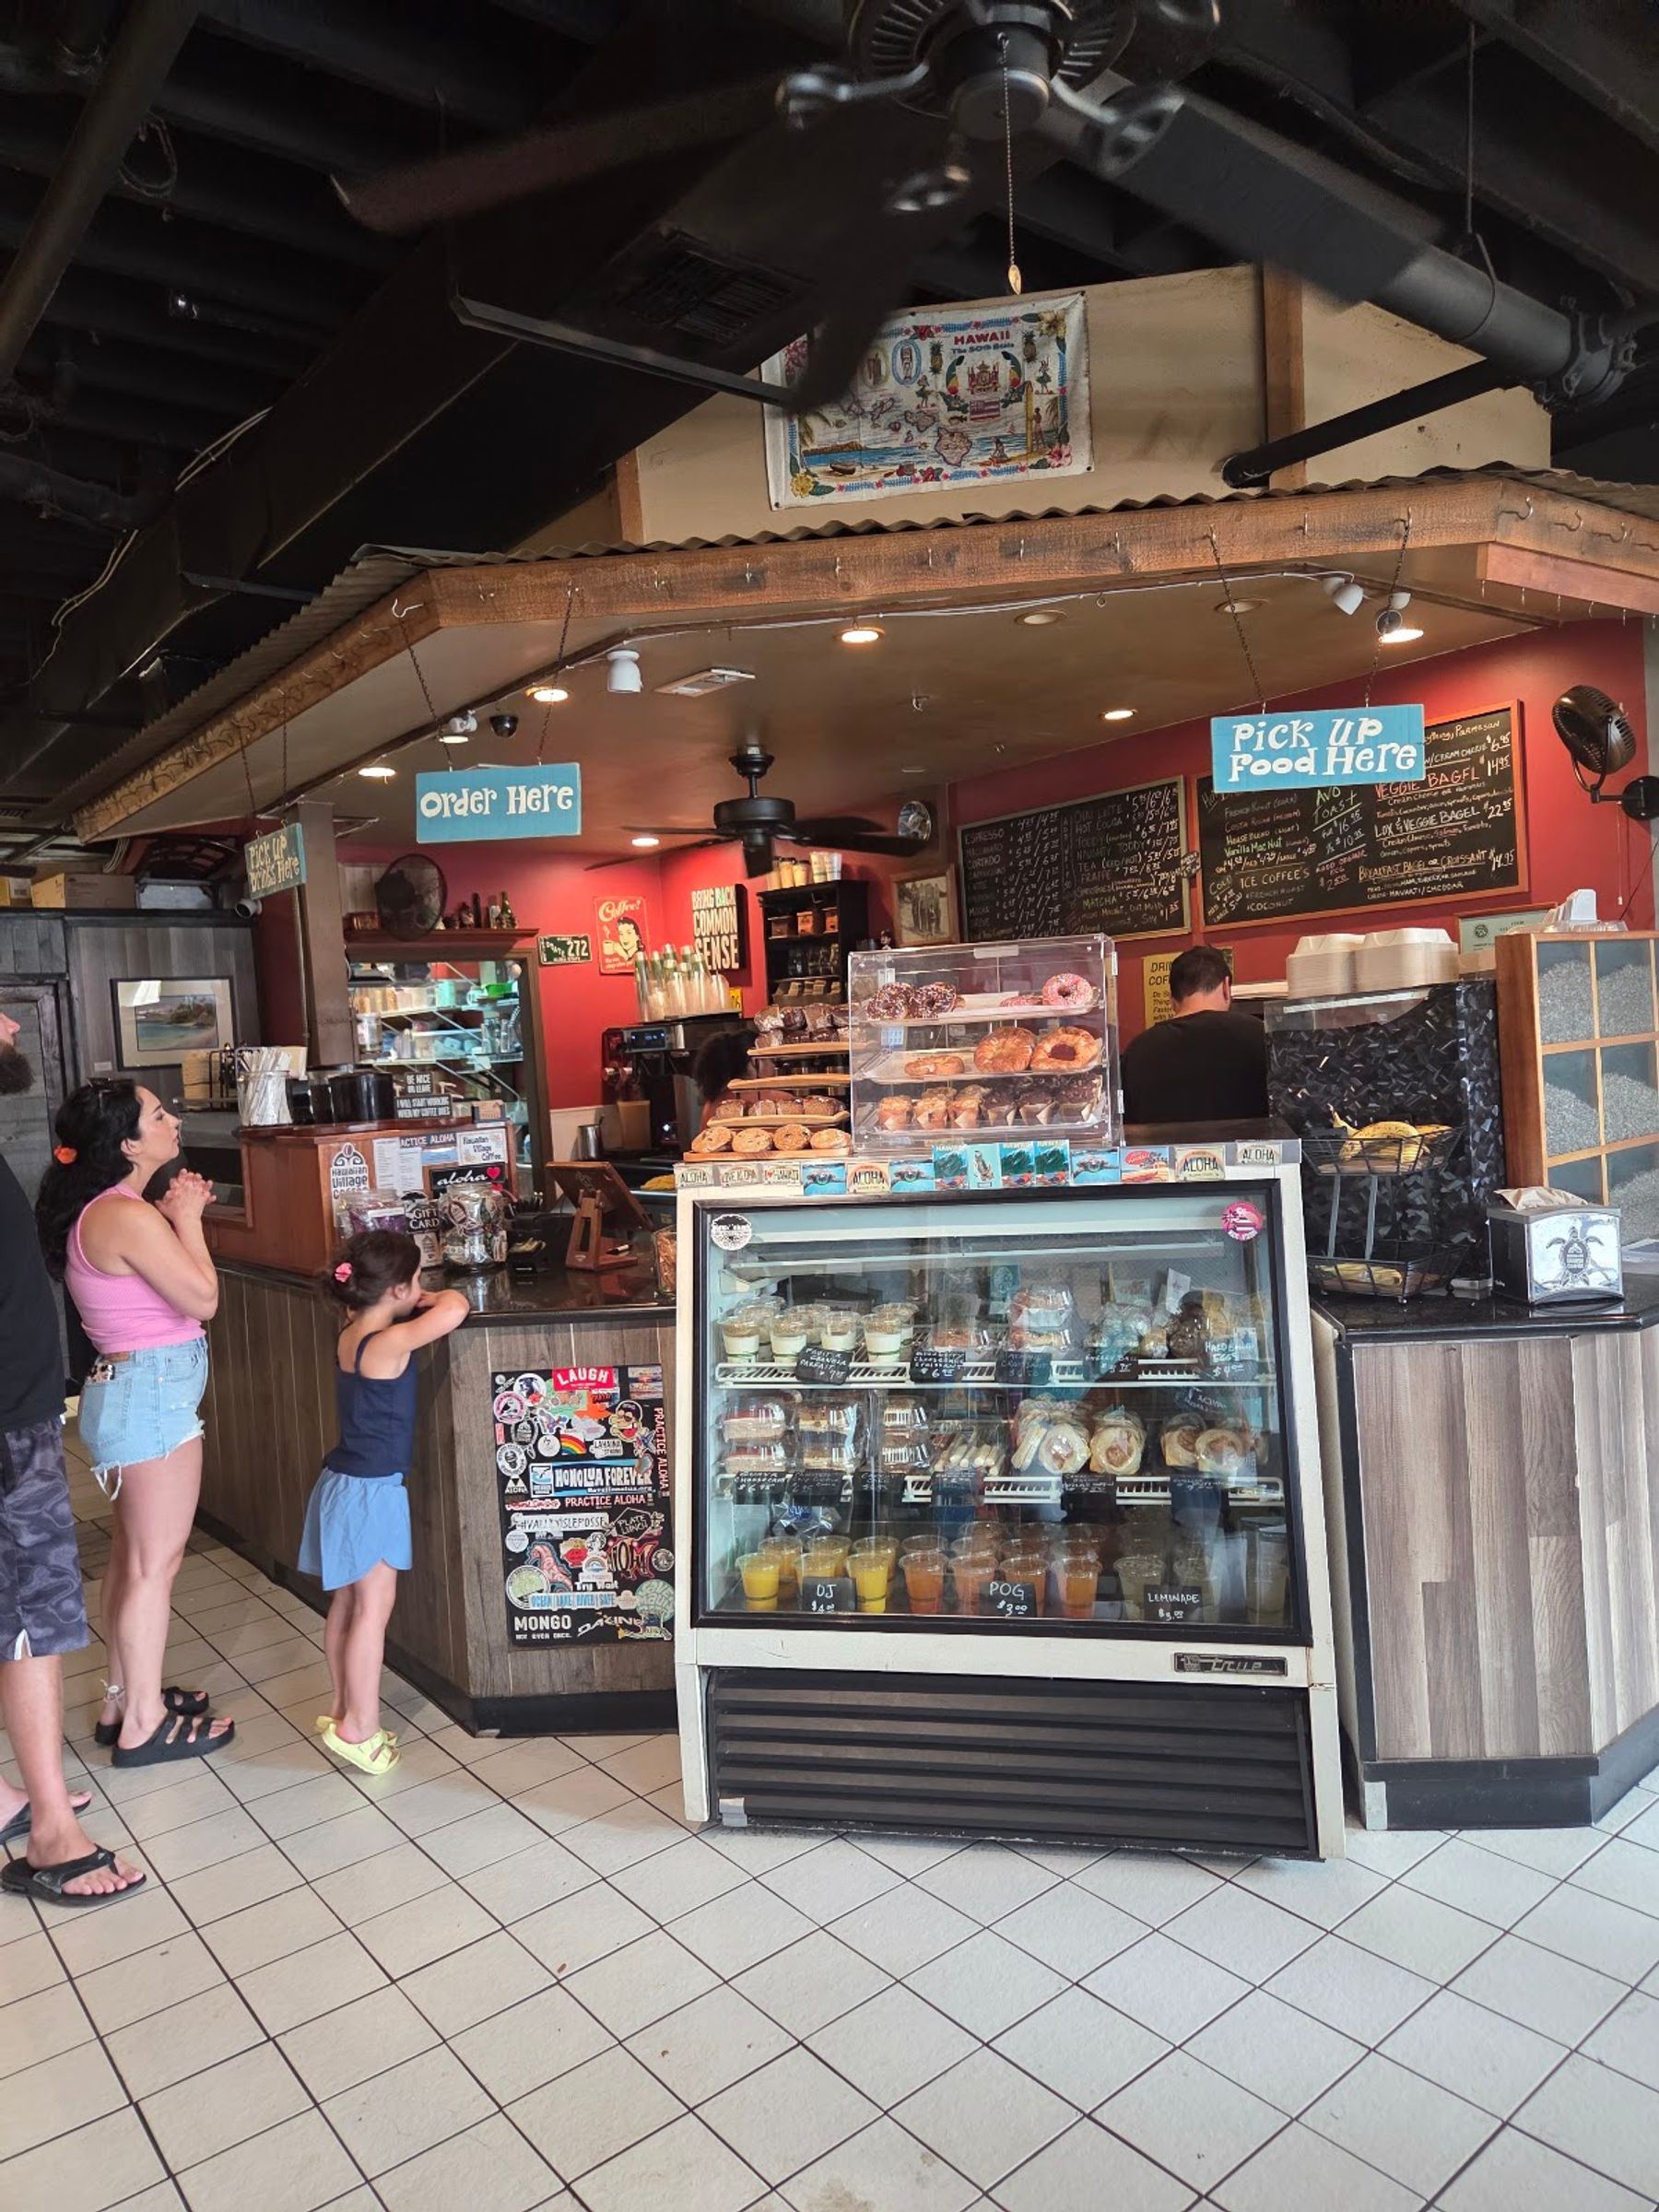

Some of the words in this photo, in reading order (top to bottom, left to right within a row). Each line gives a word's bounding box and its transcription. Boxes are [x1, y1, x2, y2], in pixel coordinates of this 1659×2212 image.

[954, 330, 1011, 346] HAWAII
[1228, 747, 1318, 782] Food
[1322, 742, 1418, 775] Here
[1427, 767, 1480, 785] BAGEL
[420, 787, 498, 818] Order
[506, 783, 574, 815] Here
[1404, 815, 1439, 832] VEGGIE
[1440, 806, 1480, 824] BAGEL
[277, 855, 300, 884] Here
[1077, 861, 1097, 873] TEA
[1241, 877, 1259, 889] ICE
[692, 888, 715, 911] BRING
[693, 905, 737, 937] COMMON
[567, 939, 589, 957] 272
[695, 934, 739, 971] SENSE
[1148, 975, 1170, 986] COF
[406, 1075, 415, 1085] BE
[416, 1074, 431, 1084] NICE
[430, 1133, 456, 1145] ALOHA
[1243, 1148, 1275, 1160] ALOHA
[332, 1166, 368, 1177] Hawaiian
[1183, 1157, 1219, 1171] ALOHA
[332, 1175, 368, 1189] Village
[437, 1170, 488, 1186] aloha
[681, 1171, 708, 1182] ALOHA
[853, 1170, 886, 1185] ALOHA
[414, 1208, 438, 1219] GIFT
[410, 1218, 440, 1230] CARD
[556, 1367, 609, 1385] LAUGH
[653, 1407, 666, 1455] PRACTICE
[555, 1467, 604, 1488] HONOLUA
[604, 1465, 653, 1487] FOREVER
[657, 1456, 668, 1489] ALOHA
[565, 1496, 612, 1508] PRACTICE
[614, 1494, 646, 1505] ALOHA
[990, 1581, 1025, 1601] POG
[531, 1595, 553, 1607] OCEAN
[513, 1615, 571, 1631] MONGO
